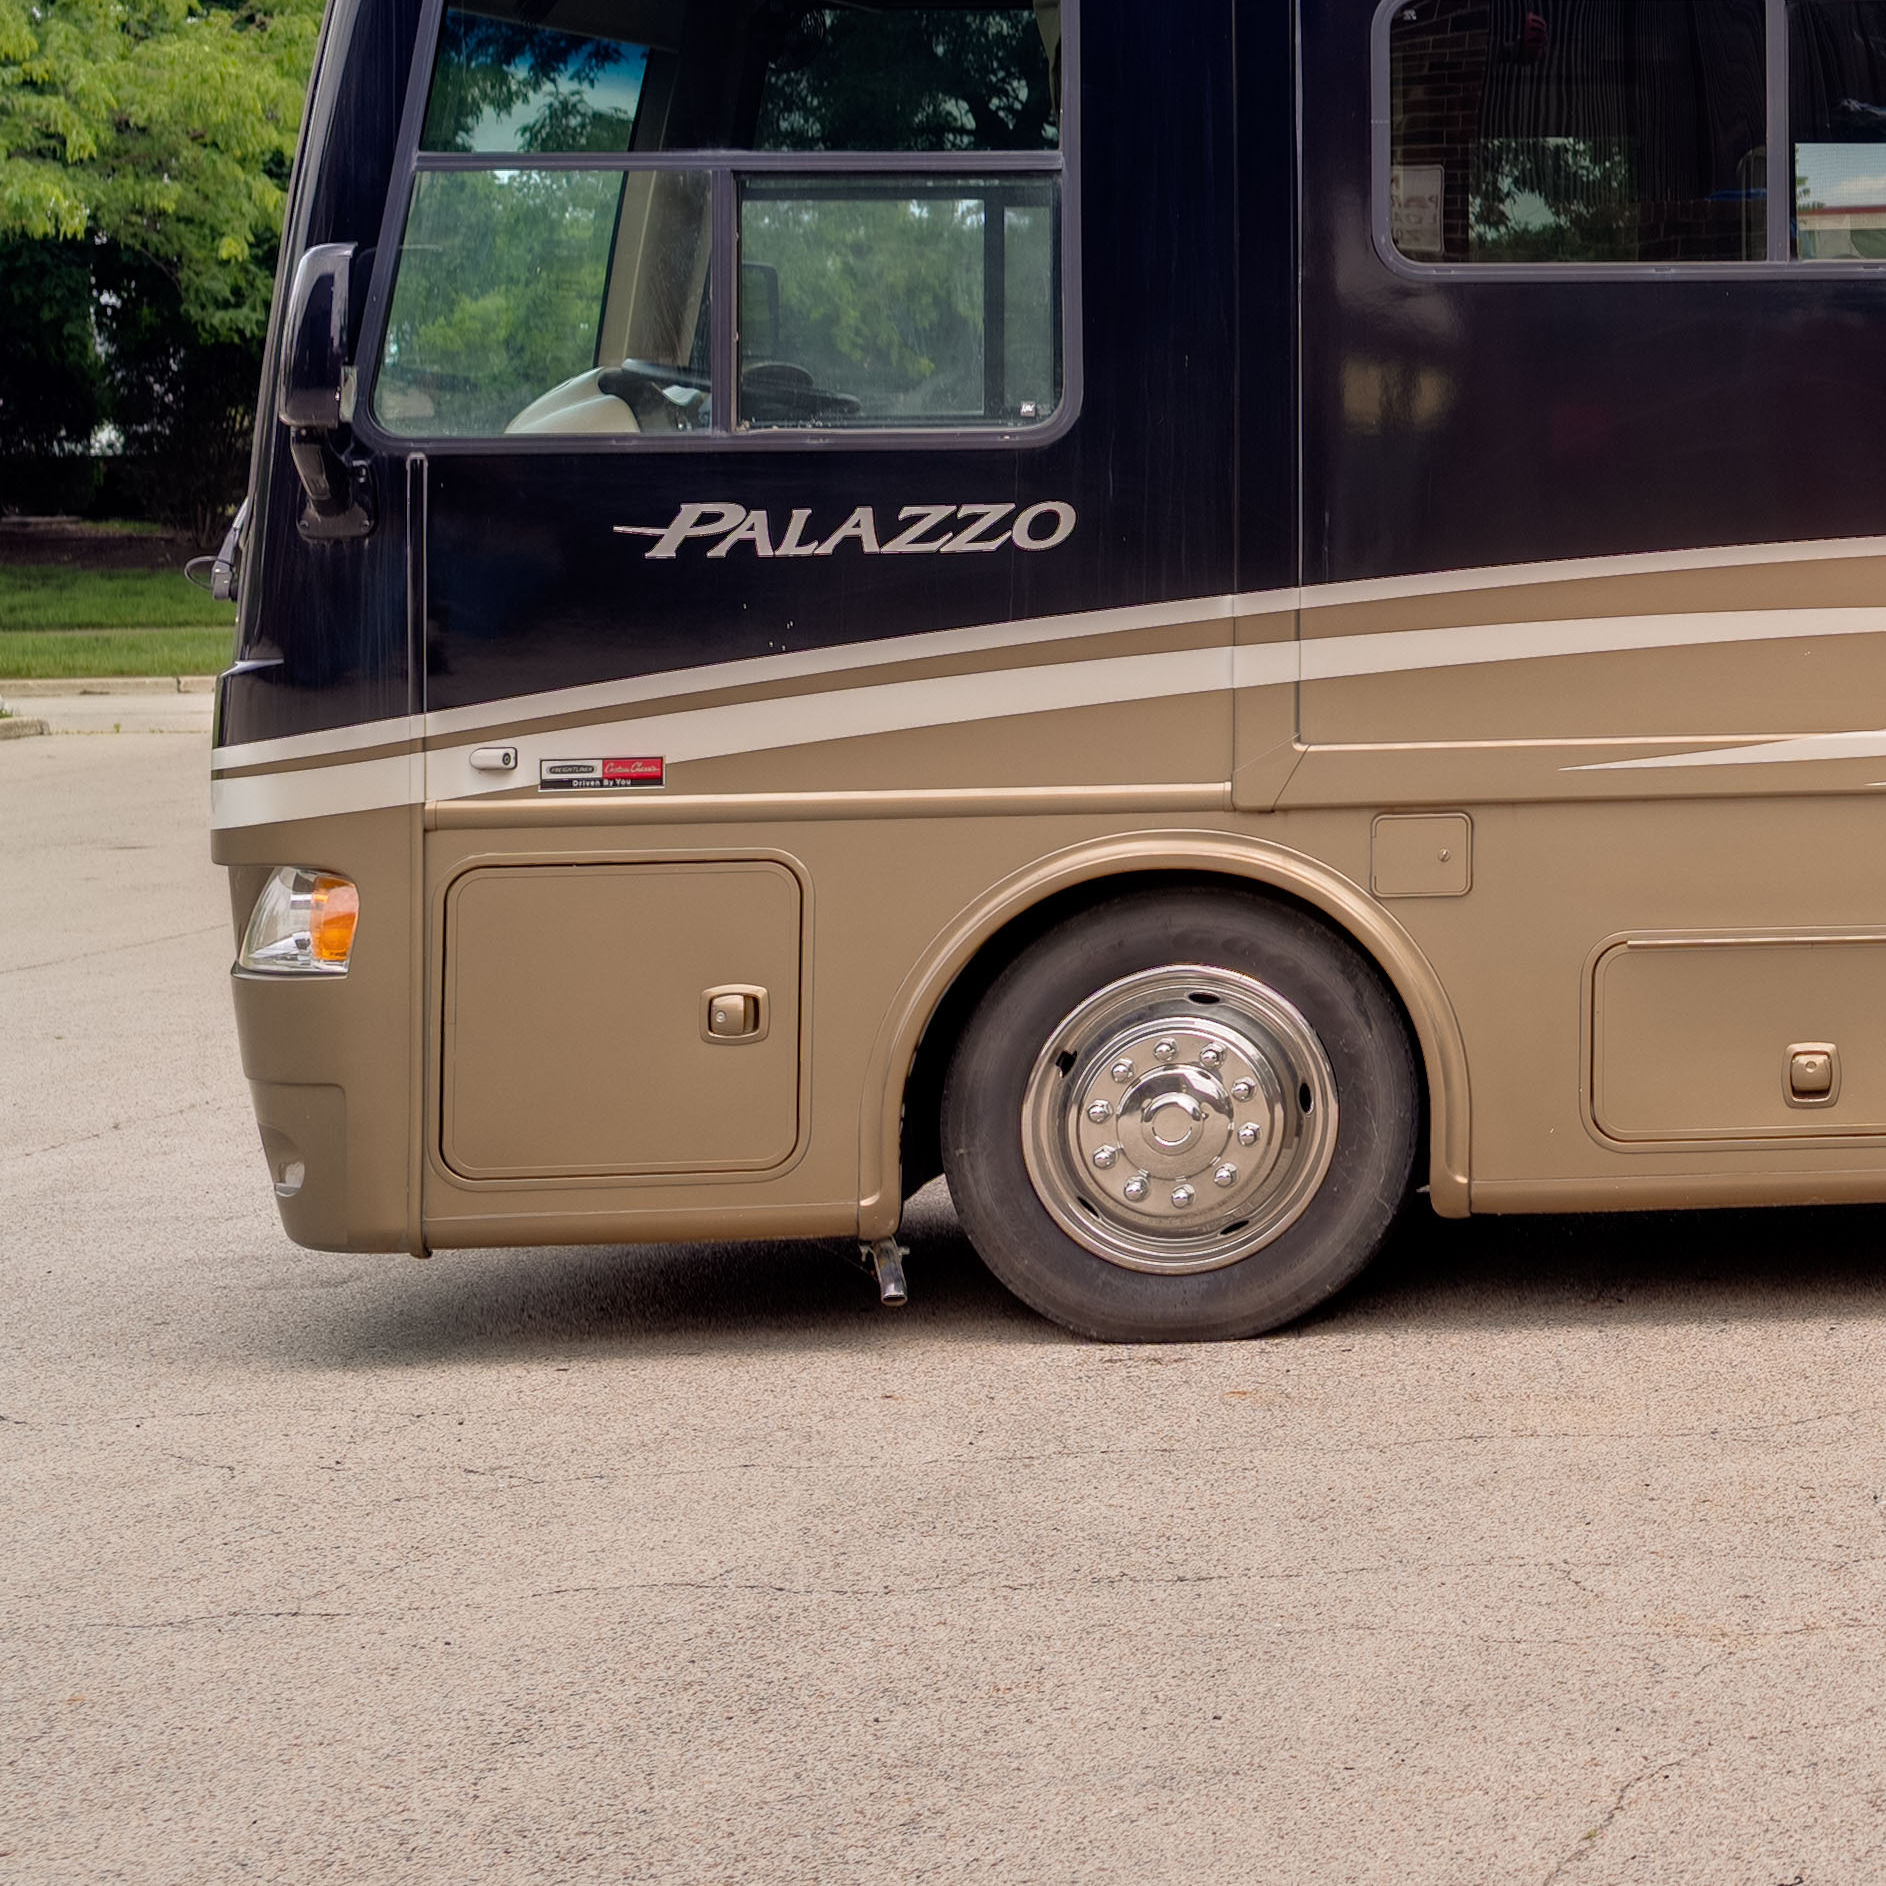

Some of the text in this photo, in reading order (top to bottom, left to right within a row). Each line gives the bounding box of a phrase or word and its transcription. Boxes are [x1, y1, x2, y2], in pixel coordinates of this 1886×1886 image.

[613, 500, 1078, 559] PALAZZO
[572, 779, 600, 787] Driven
[603, 779, 613, 787] By
